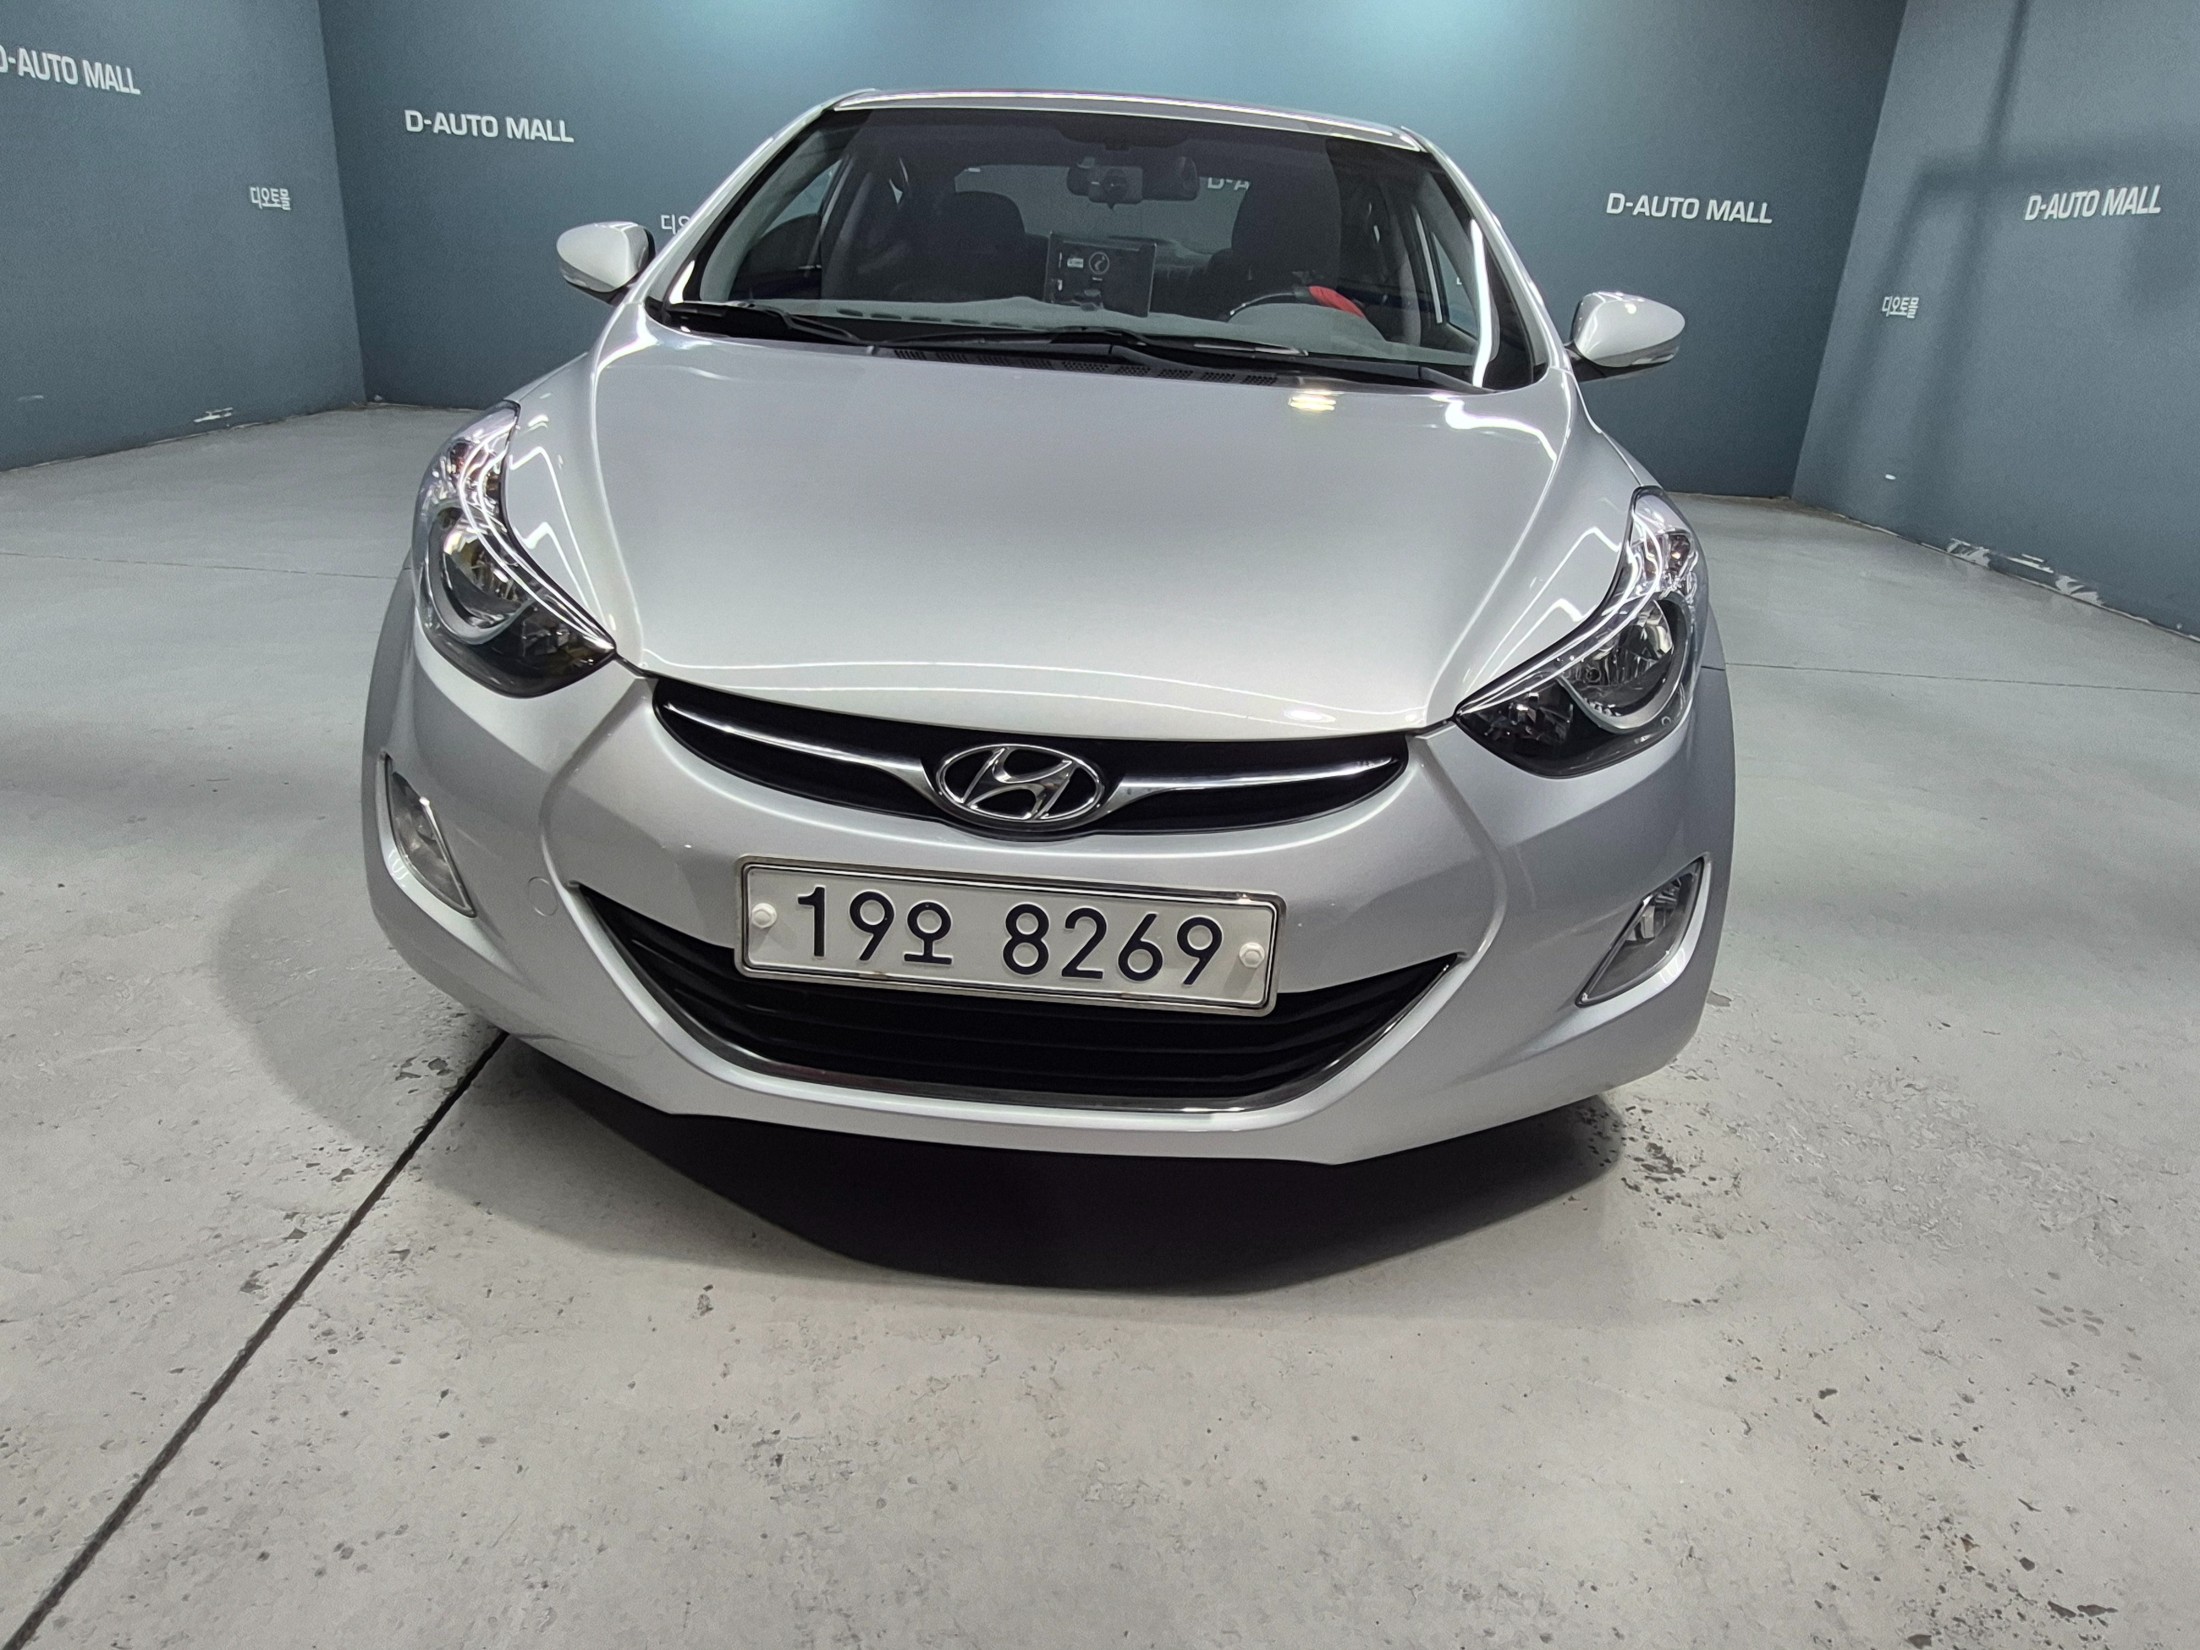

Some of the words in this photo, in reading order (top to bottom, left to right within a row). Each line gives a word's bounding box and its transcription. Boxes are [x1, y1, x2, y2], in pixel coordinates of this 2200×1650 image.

[83, 60, 141, 95] MALL
[404, 110, 499, 138] D-AUTO
[505, 116, 575, 143] MALL
[250, 186, 291, 211] 디오토몰
[1606, 192, 1700, 220] D-AUTO
[1705, 199, 1773, 224] MALL
[2024, 190, 2101, 221] D-AUTO
[2101, 185, 2162, 217] MALL
[1881, 296, 1920, 319] 디오토몰
[797, 885, 953, 966] 19오
[1002, 902, 1224, 986] 8269
